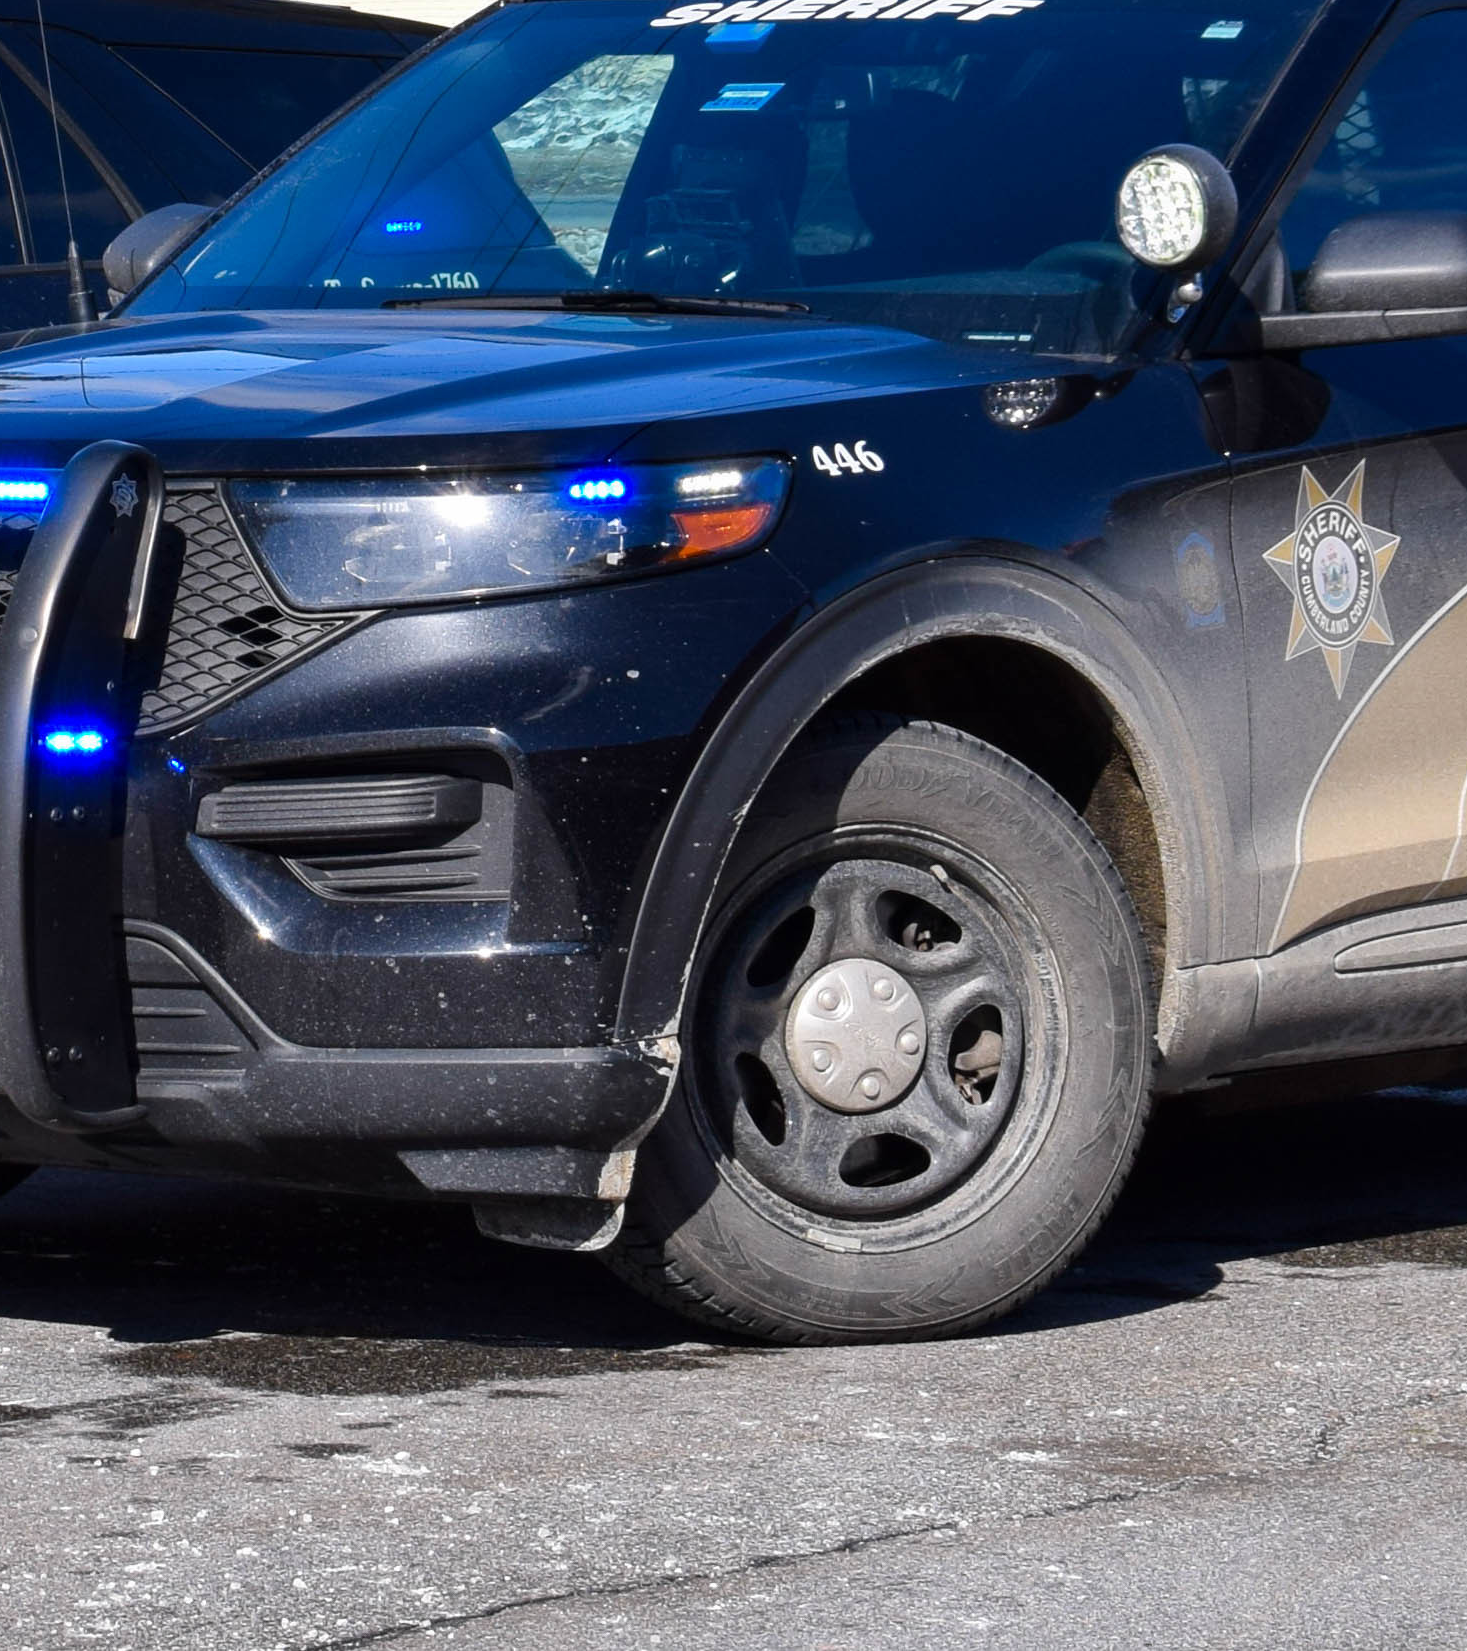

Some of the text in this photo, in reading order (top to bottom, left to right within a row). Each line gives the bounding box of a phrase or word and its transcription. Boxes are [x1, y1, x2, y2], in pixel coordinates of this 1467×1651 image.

[812, 440, 884, 476] 446
[1299, 511, 1366, 564] SHERIFF
[1301, 569, 1370, 634] CUMBERLAND COUNTY
